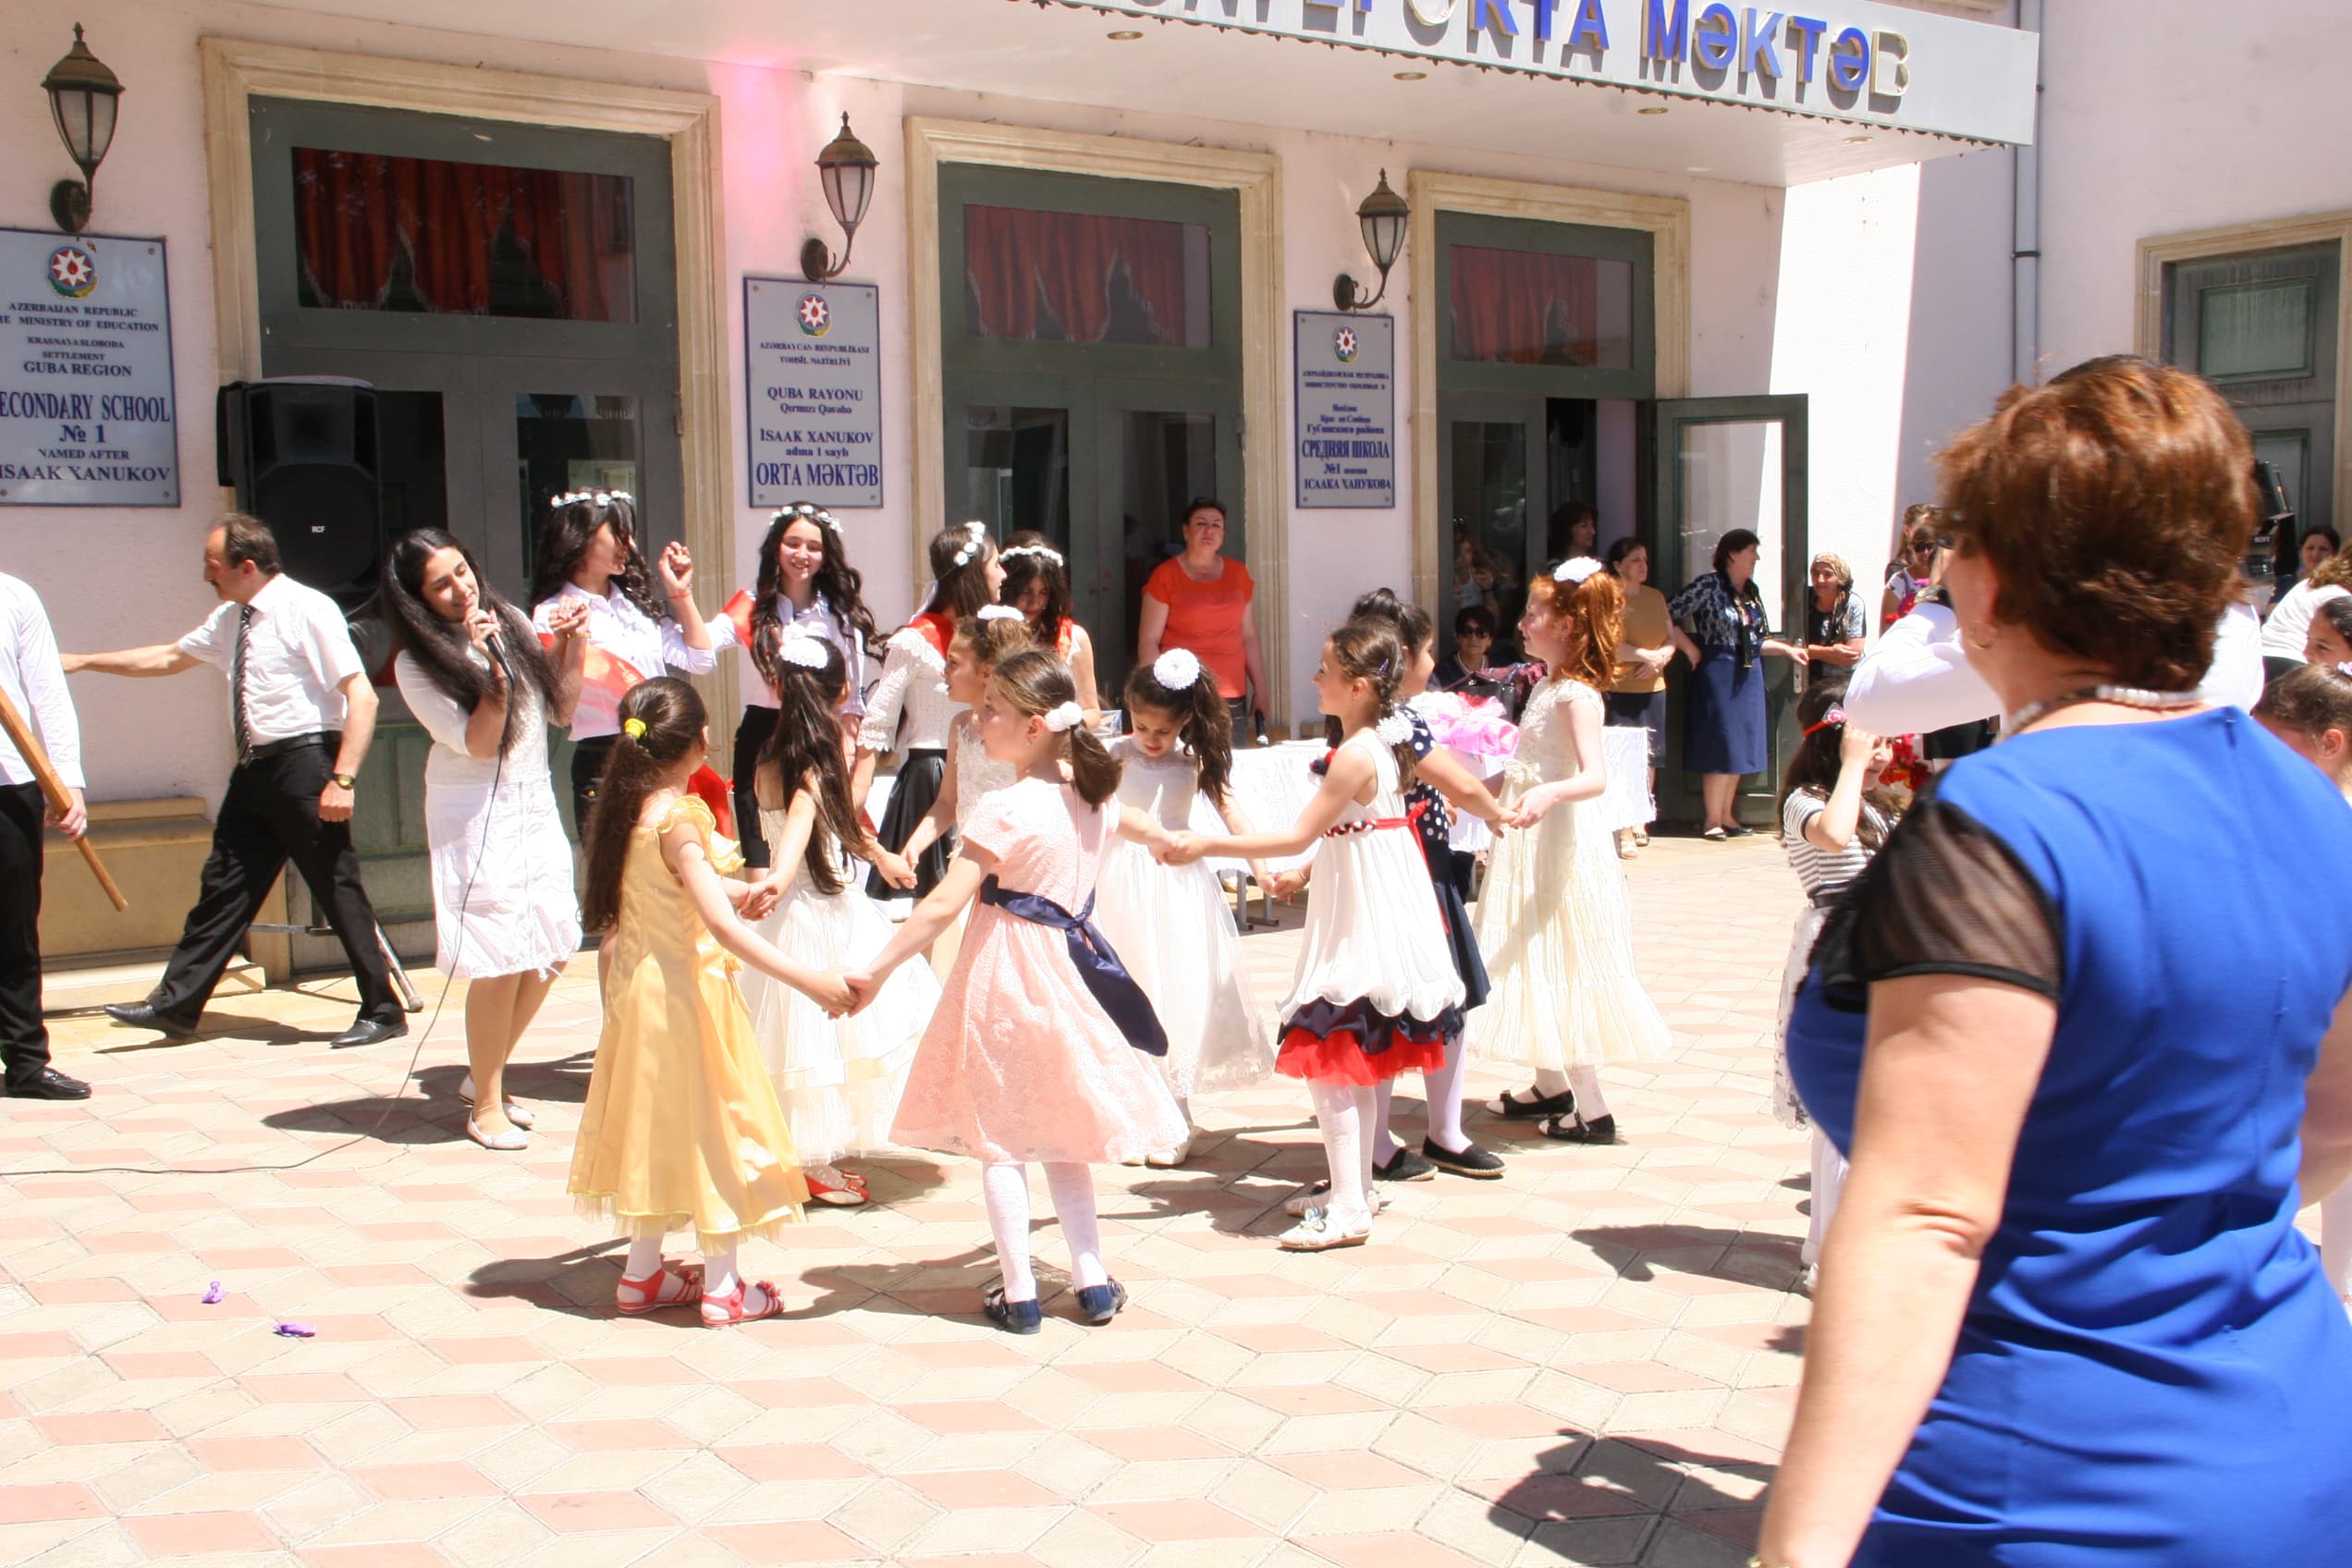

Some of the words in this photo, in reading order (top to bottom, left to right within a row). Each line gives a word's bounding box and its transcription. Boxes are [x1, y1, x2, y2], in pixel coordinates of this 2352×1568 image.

[1642, 0, 1910, 97] MƏKTƏB
[8, 302, 79, 314] AZERBAIJAN
[84, 306, 138, 317] REPUBLIC
[18, 316, 73, 328] MINISTRY
[77, 320, 93, 328] OF
[96, 321, 159, 332] EDUCATION
[80, 339, 125, 349] SLOBODA
[42, 350, 105, 361] SETTLEMENT
[23, 361, 68, 374] GUBA
[71, 362, 133, 377] REGION
[767, 386, 803, 400] QUBA
[809, 387, 864, 401] RAYONU
[102, 395, 171, 423] SCHOOL
[95, 423, 106, 443] 1
[807, 430, 873, 444] XANUKOV
[38, 447, 86, 459] NAMED
[89, 449, 130, 460] AFTER
[1302, 439, 1350, 461] СРЕДНЯЯ
[1352, 440, 1390, 459] ШКОЛА
[67, 464, 171, 482] XANUKOV
[756, 462, 802, 485] ORTA
[806, 463, 878, 486] MƏKTƏB
